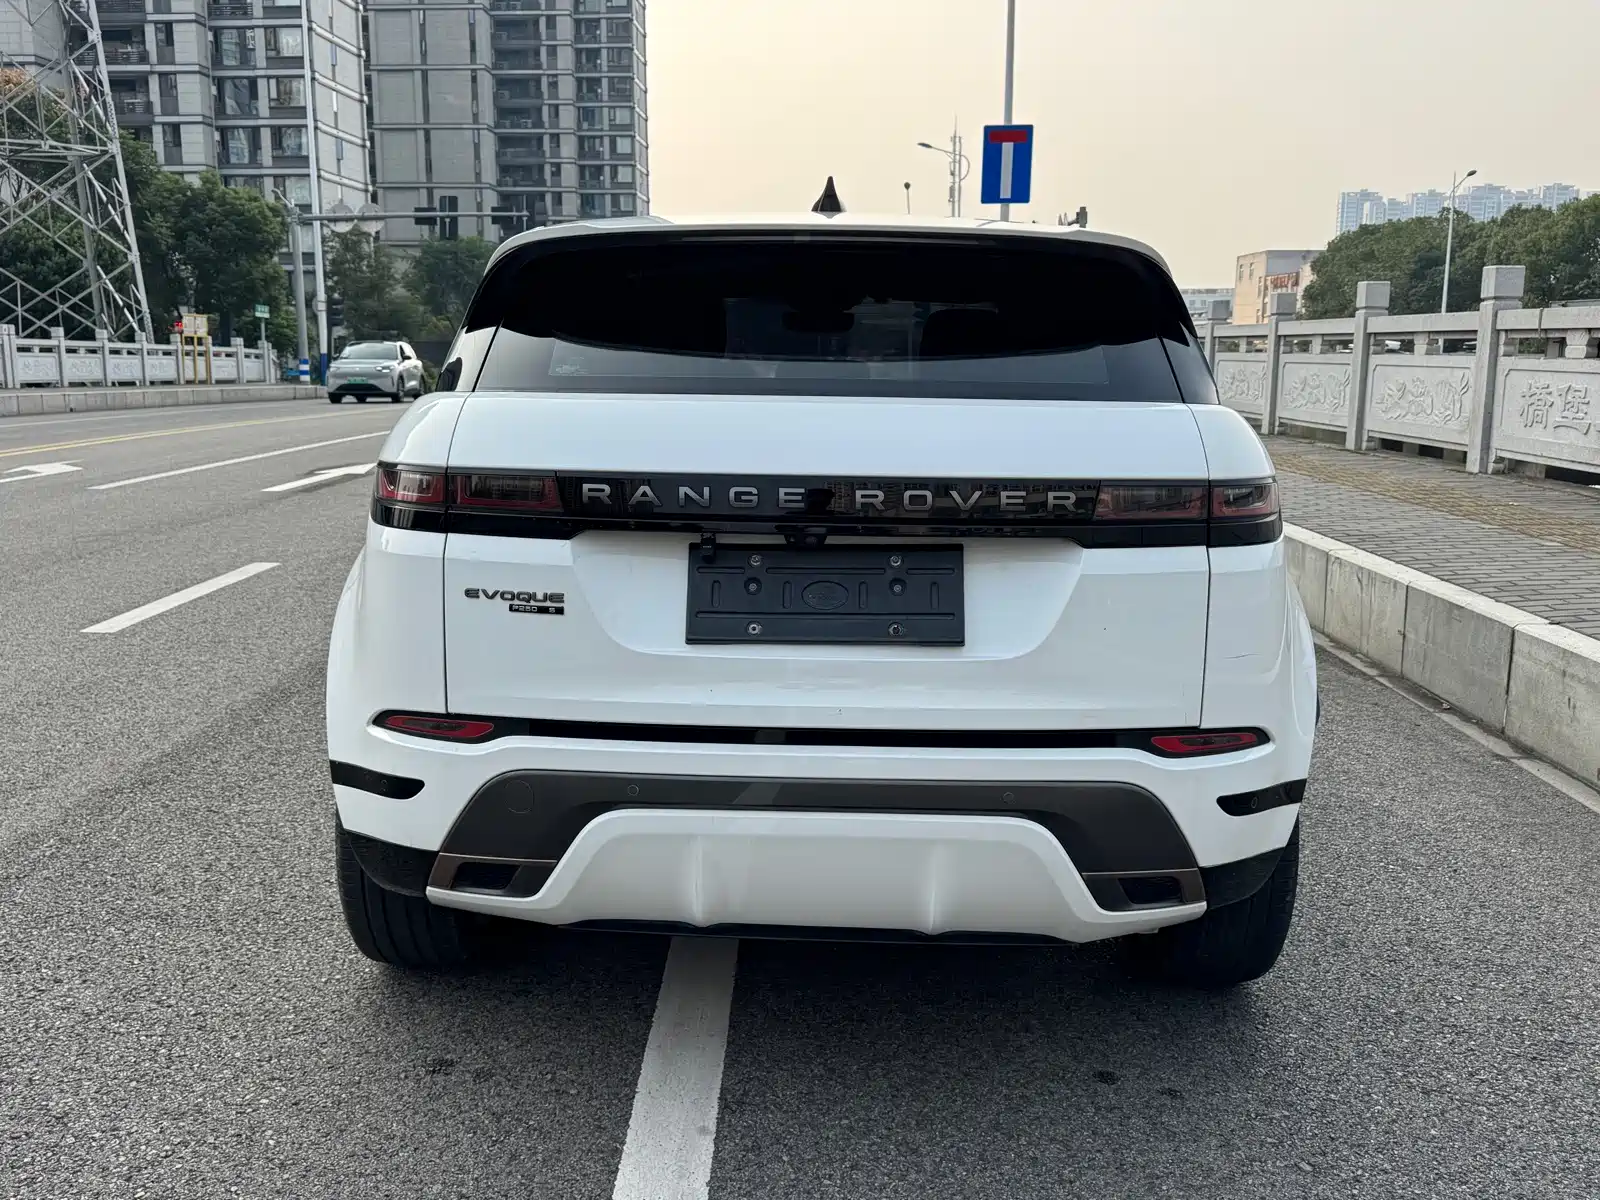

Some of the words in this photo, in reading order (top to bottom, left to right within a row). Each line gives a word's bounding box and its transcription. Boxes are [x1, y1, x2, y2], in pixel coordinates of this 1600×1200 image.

[582, 483, 805, 508] RANGE
[855, 489, 1077, 512] ROVER
[464, 587, 565, 604] EVOQUE
